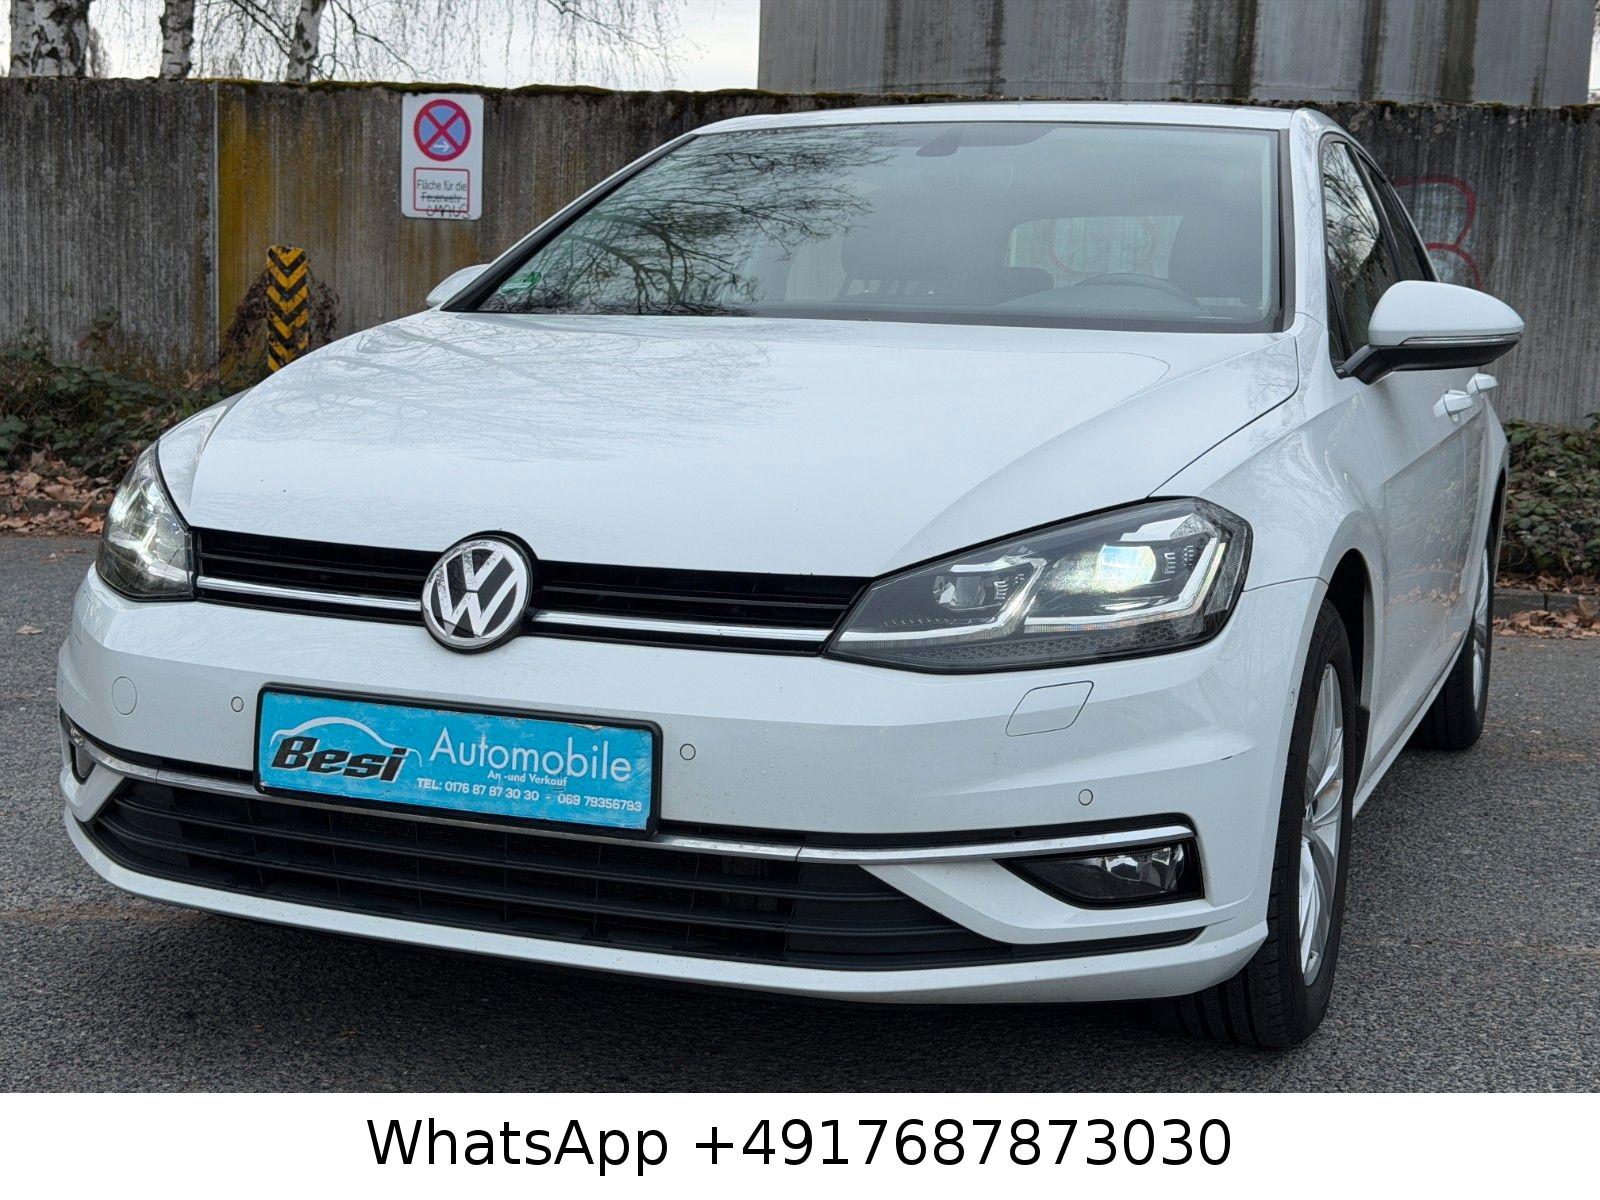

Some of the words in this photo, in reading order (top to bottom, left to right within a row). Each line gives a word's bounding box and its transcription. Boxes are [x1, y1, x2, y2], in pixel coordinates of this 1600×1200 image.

[417, 179, 442, 191] Fläche
[444, 180, 454, 191] für
[455, 181, 468, 192] die
[271, 736, 408, 783] Besi
[429, 726, 632, 782] Automobile
[487, 769, 501, 780] An
[528, 773, 568, 787] Verkauf
[416, 777, 442, 790] TEL:
[444, 781, 470, 794] 0176
[472, 784, 486, 795] 87
[488, 786, 504, 797] 87
[504, 787, 521, 799] 30
[523, 790, 540, 801] 30
[557, 793, 581, 806] 069
[583, 795, 642, 812] 79356793
